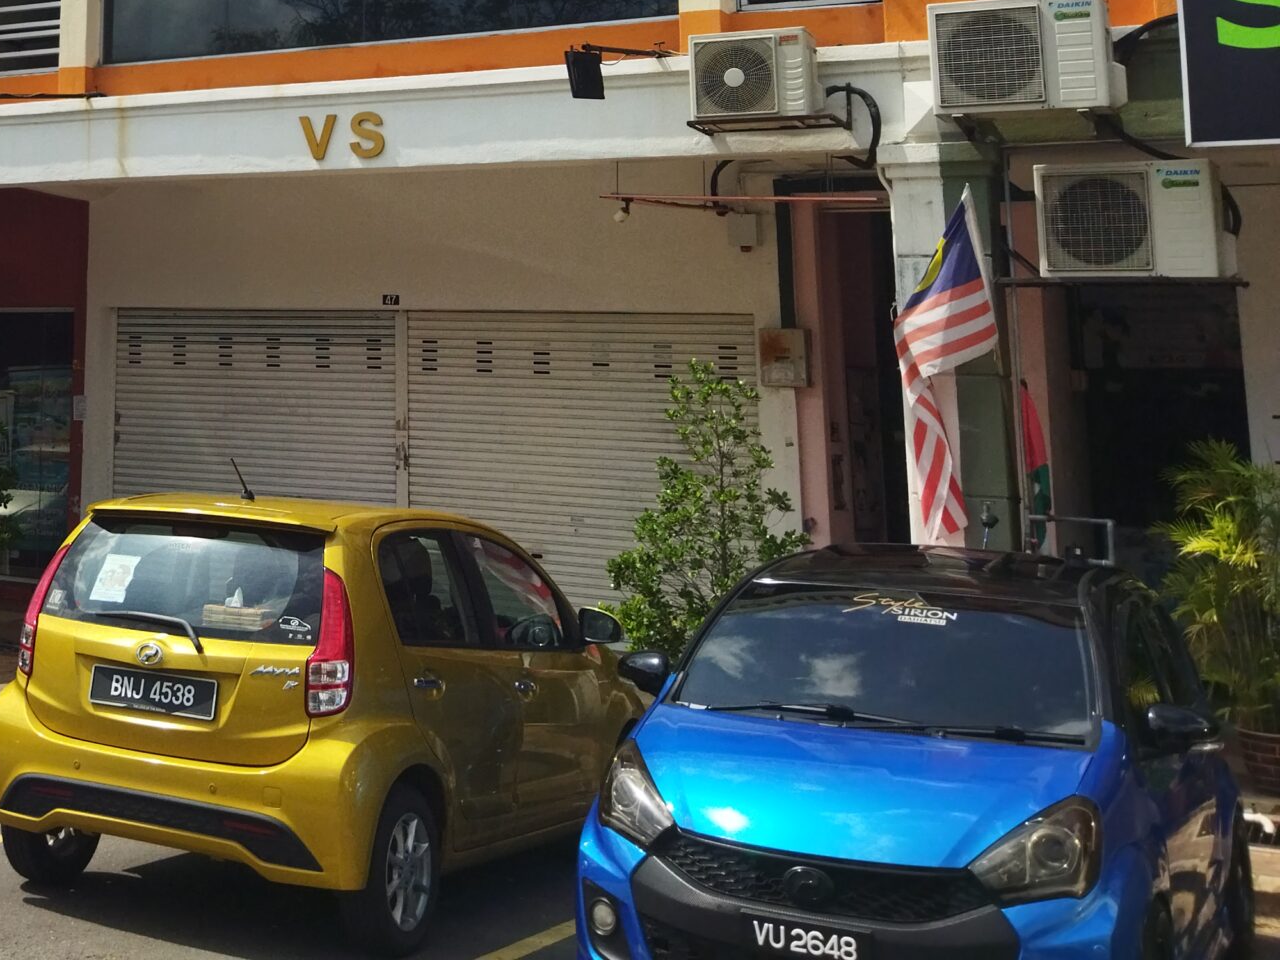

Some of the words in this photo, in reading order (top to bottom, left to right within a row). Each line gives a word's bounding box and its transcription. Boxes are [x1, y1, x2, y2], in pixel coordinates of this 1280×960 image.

[1057, 1, 1092, 9] DAIKIN
[385, 295, 396, 305] 47
[891, 607, 958, 621] SIRION
[110, 674, 145, 699] BNJ
[149, 681, 195, 707] 4538
[753, 920, 785, 949] VU
[789, 928, 858, 960] 2648
